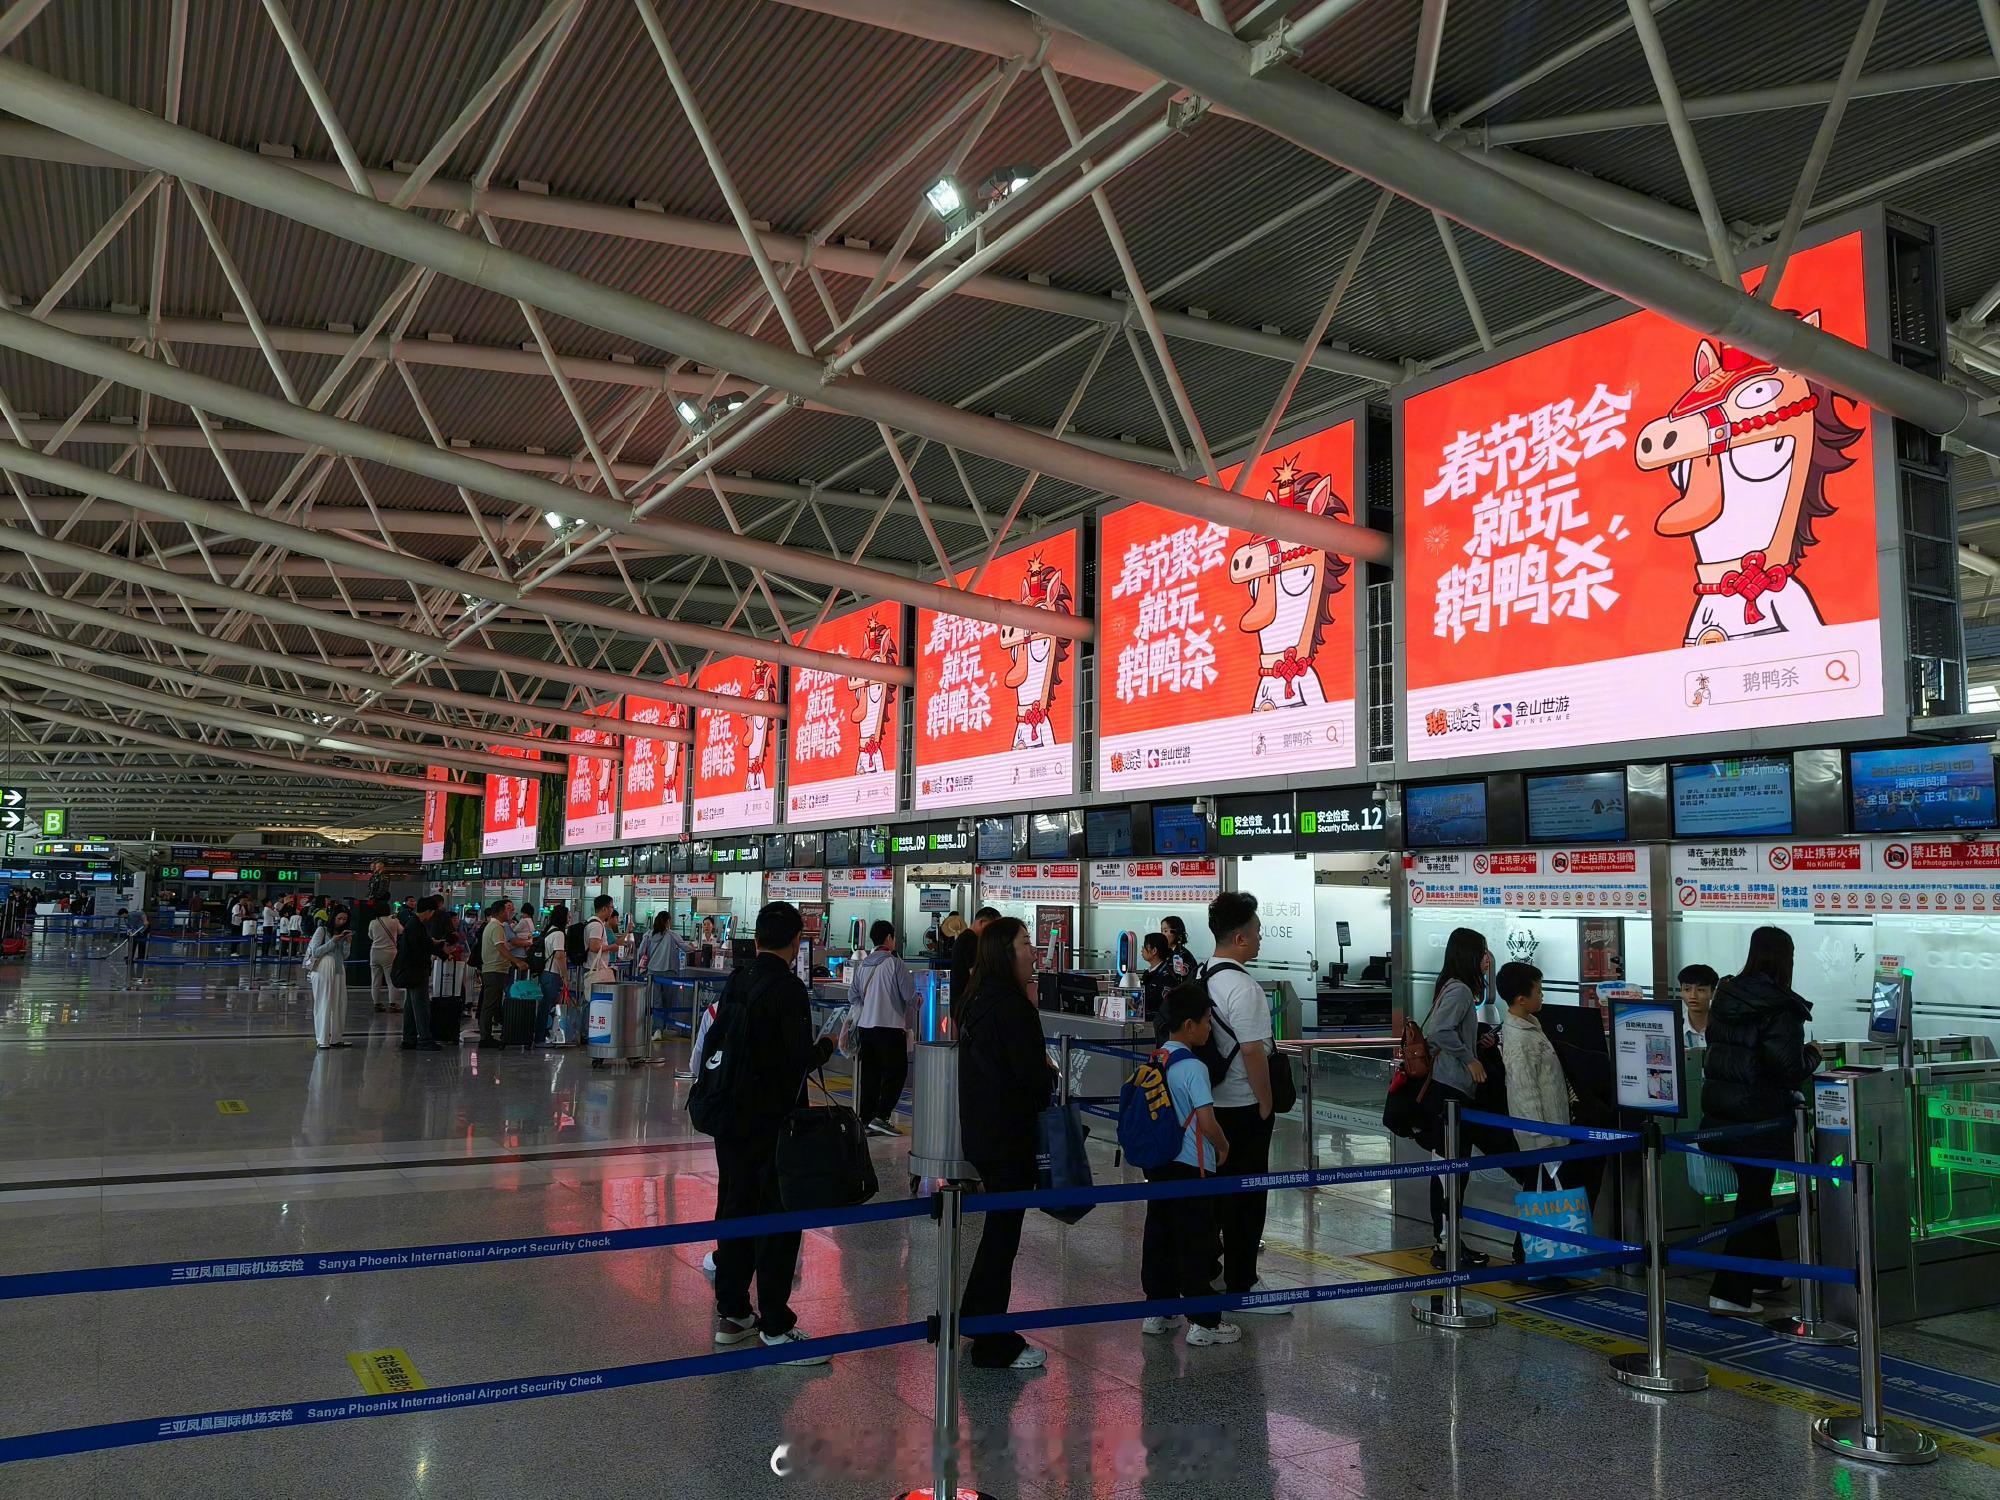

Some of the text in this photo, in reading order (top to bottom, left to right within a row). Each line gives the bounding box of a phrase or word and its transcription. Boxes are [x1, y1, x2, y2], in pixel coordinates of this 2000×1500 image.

[1424, 383, 1633, 507] 春节聚会
[1463, 472, 1589, 557] 就玩
[1112, 521, 1230, 600] 春节聚会
[1433, 533, 1621, 644] 鹅鸭杀
[1133, 581, 1205, 641] 就玩
[938, 646, 984, 691] 就玩
[1116, 628, 1220, 705] 鹅鸭杀
[1742, 667, 1800, 693] 鹅鸭杀
[804, 687, 837, 721] 就玩
[926, 681, 993, 740] 鹅鸭杀
[1515, 696, 1570, 719] 金山世游
[1425, 702, 1480, 737] 鹅鸭杀
[795, 718, 842, 764] 鹅鸭杀
[1283, 731, 1313, 750] 鹅鸭杀
[1160, 746, 1191, 761] 金山世游
[47, 813, 61, 831] B
[1234, 814, 1263, 828] 安全检查
[1272, 812, 1292, 834] 11
[1317, 808, 1350, 824] 安全检查
[1361, 806, 1383, 831] 12
[1234, 826, 1272, 837] Security Check
[1317, 822, 1360, 834] Security Check
[916, 835, 925, 851] 09
[957, 833, 967, 849] 10
[1417, 854, 1459, 864] 请在一米黄线外
[1490, 853, 1537, 865] 禁止携带火种
[1570, 851, 1635, 864] 禁止拍照及摄像
[1687, 847, 1747, 858] 请在一米黄线外
[1793, 846, 1860, 859] 禁止携带火种
[1426, 863, 1451, 871] 等待过检
[1507, 865, 1527, 873] Kindling
[1578, 864, 1606, 872] Photography
[1611, 863, 1635, 871] Recording
[1700, 857, 1734, 867] 等待过检
[1806, 860, 1846, 869] No Kindling
[1922, 859, 1965, 867] Photography
[31, 871, 46, 879] C2
[59, 872, 73, 881] C3
[161, 868, 180, 878] B9
[240, 868, 262, 880] B10
[278, 869, 298, 881] B11
[1700, 883, 1776, 892] 隐藏火机火柴 违禁物品
[1781, 886, 1809, 896] 快速过
[1700, 892, 1776, 901] 最高面临十五日行政拘留
[1782, 897, 1809, 908] 检指南
[1256, 901, 1301, 917] 道关闭
[1316, 1161, 1469, 1181] Sanya Phoenix International Airport Security Check
[1240, 1173, 1309, 1188] 三亚凤凰国际机场安检
[1516, 1197, 1586, 1217] HAINAN
[318, 1236, 611, 1270] Sanya Phoenix International Airport Security Check
[171, 1258, 305, 1281] 三亚凤凰国际机场安检
[1317, 1274, 1470, 1298] Sanya Phoenix International Airport Security Check
[1241, 1290, 1310, 1306] 三亚凤凰国际机场安检
[307, 1374, 603, 1418] Sanya Phoenix International Airport Security Check
[158, 1408, 294, 1436] 三亚凤凰国际机场安检
